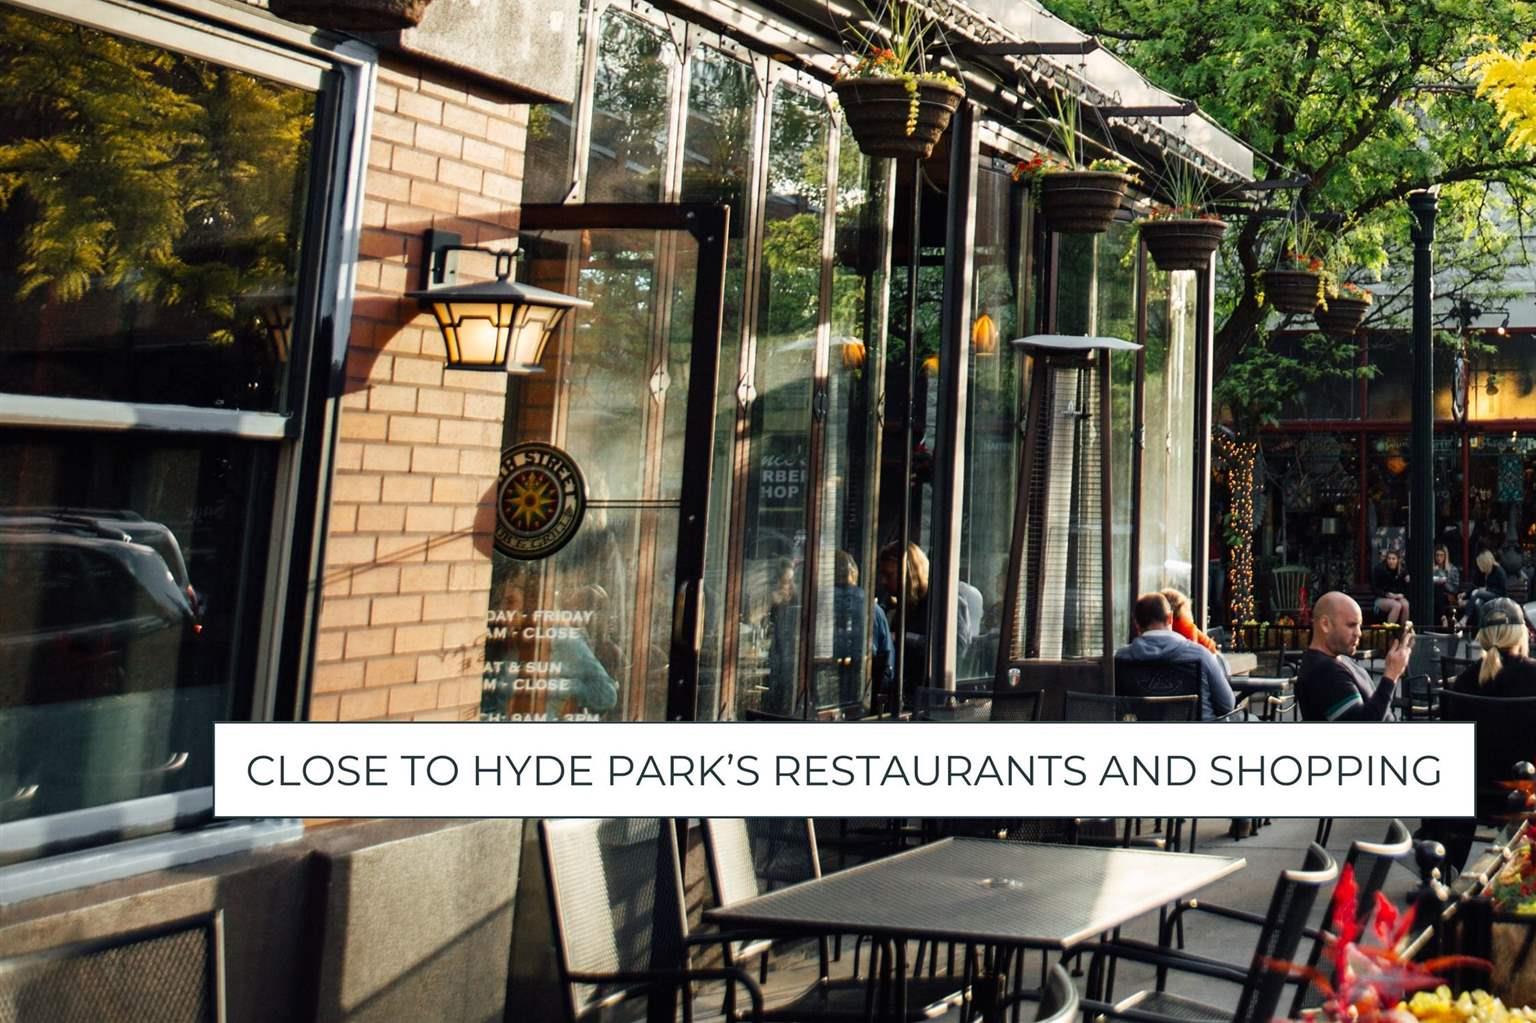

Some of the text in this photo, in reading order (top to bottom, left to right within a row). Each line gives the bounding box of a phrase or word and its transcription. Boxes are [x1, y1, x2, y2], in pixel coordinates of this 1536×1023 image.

[525, 452, 578, 498] STREET
[533, 610, 594, 622] FRIDAY
[523, 627, 580, 639] CLOSE
[508, 661, 520, 673] &
[525, 661, 562, 673] SUN
[513, 678, 571, 690] CLOSE
